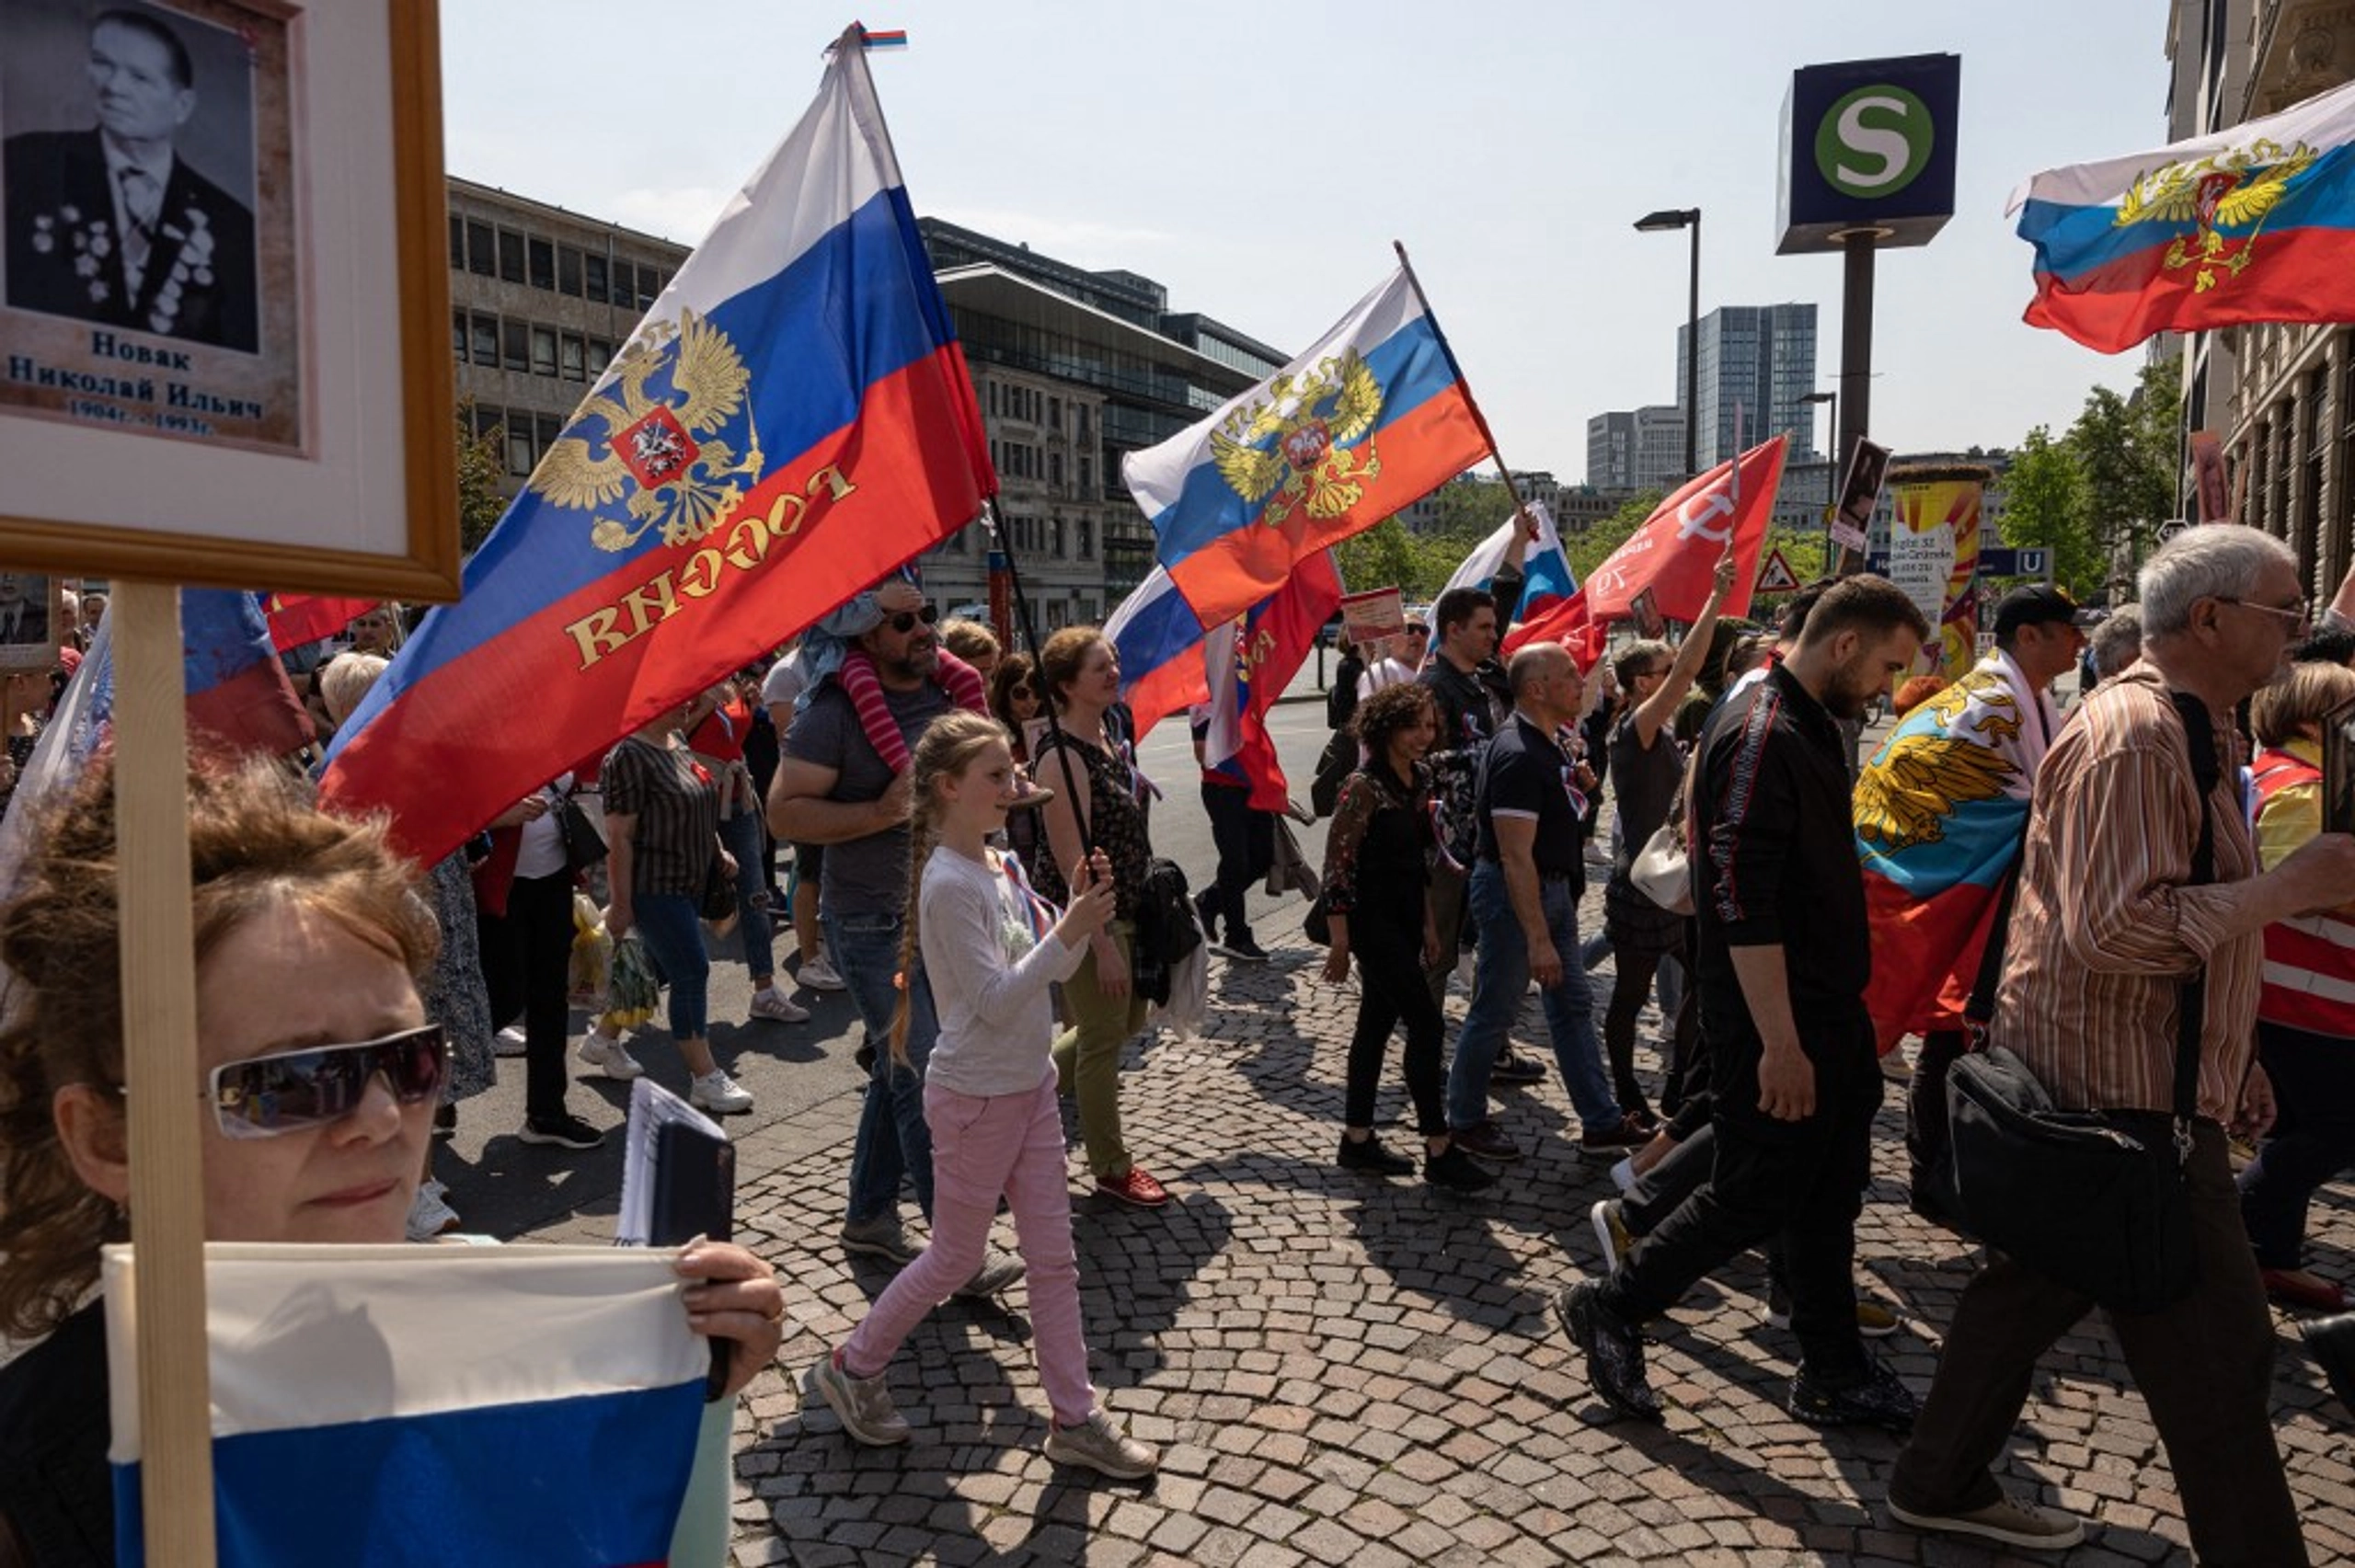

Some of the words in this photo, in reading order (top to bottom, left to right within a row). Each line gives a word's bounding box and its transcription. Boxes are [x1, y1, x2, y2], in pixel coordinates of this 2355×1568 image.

[1837, 96, 1910, 187] S
[93, 331, 192, 372] Новак
[8, 355, 155, 403] Николай
[167, 382, 263, 419] Ильич
[2023, 554, 2041, 571] U
